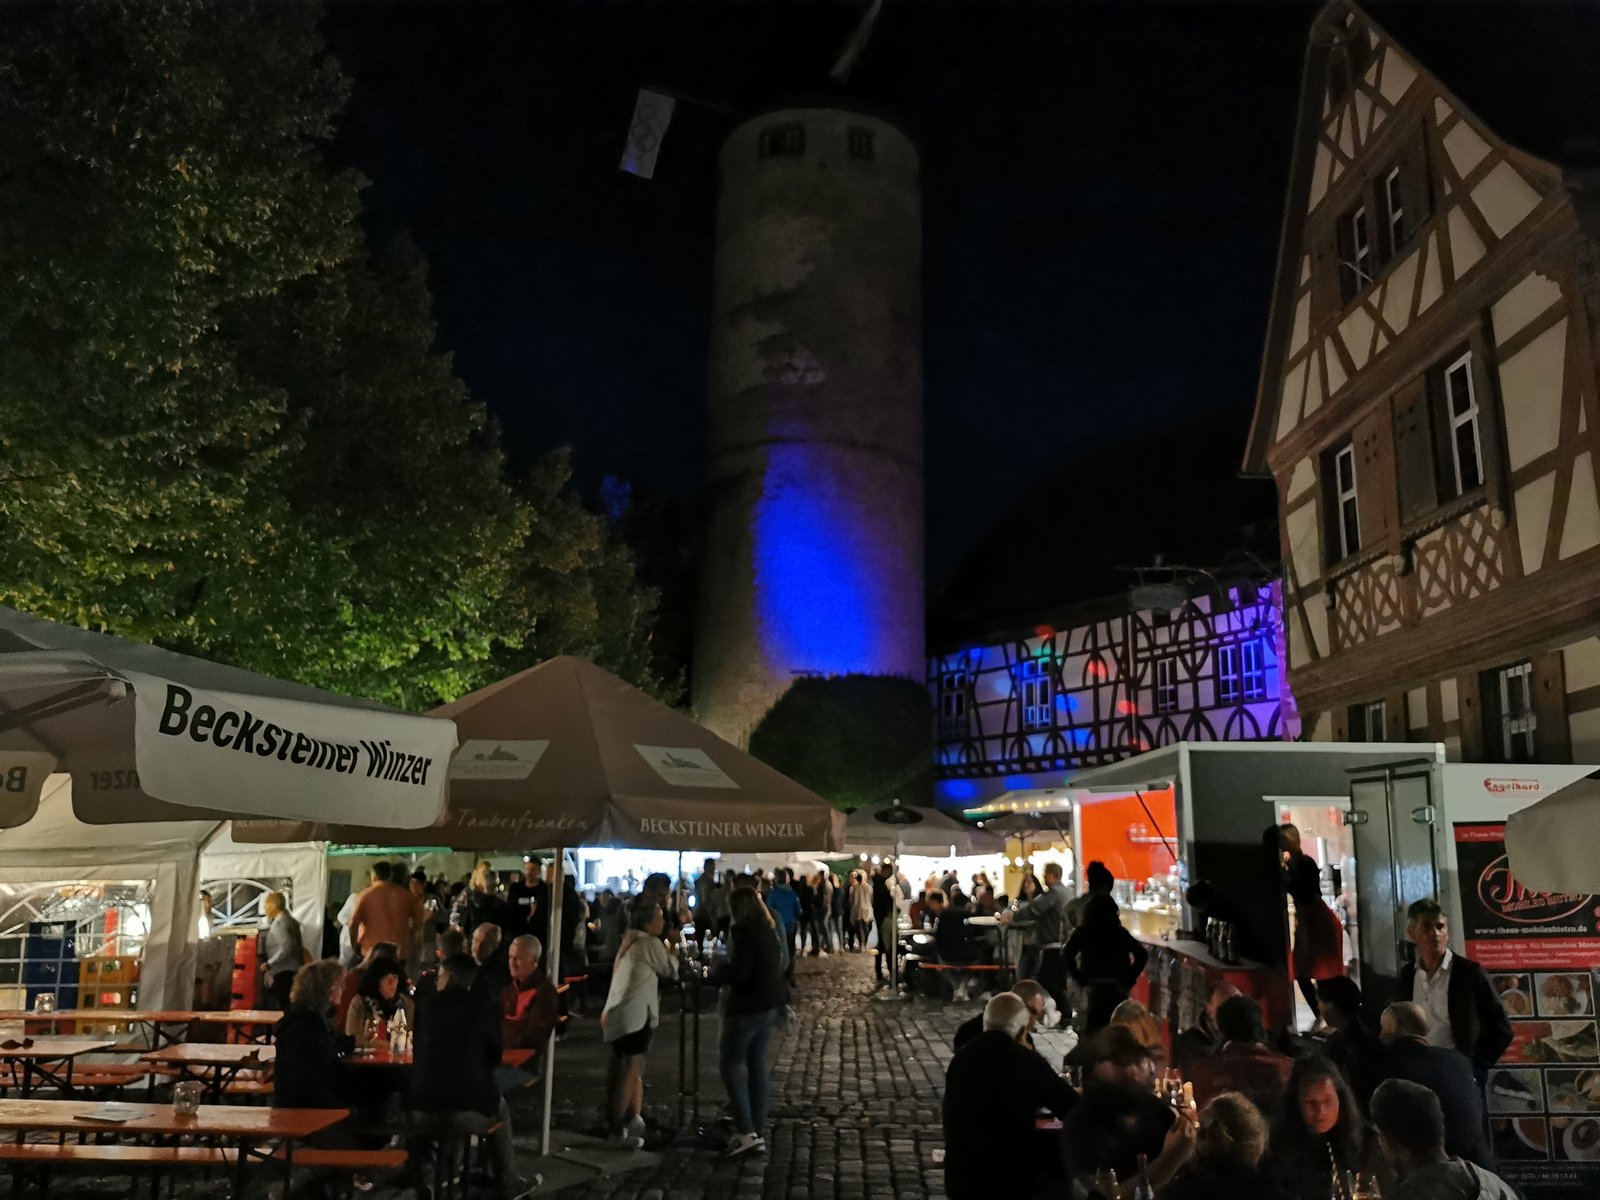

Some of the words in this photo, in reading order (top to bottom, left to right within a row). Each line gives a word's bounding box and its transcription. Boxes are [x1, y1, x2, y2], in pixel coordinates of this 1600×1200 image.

[158, 683, 359, 774] Becksteiner
[359, 738, 432, 786] Winzer
[641, 817, 743, 837] BECKSTEINER
[745, 822, 805, 838] WINZER
